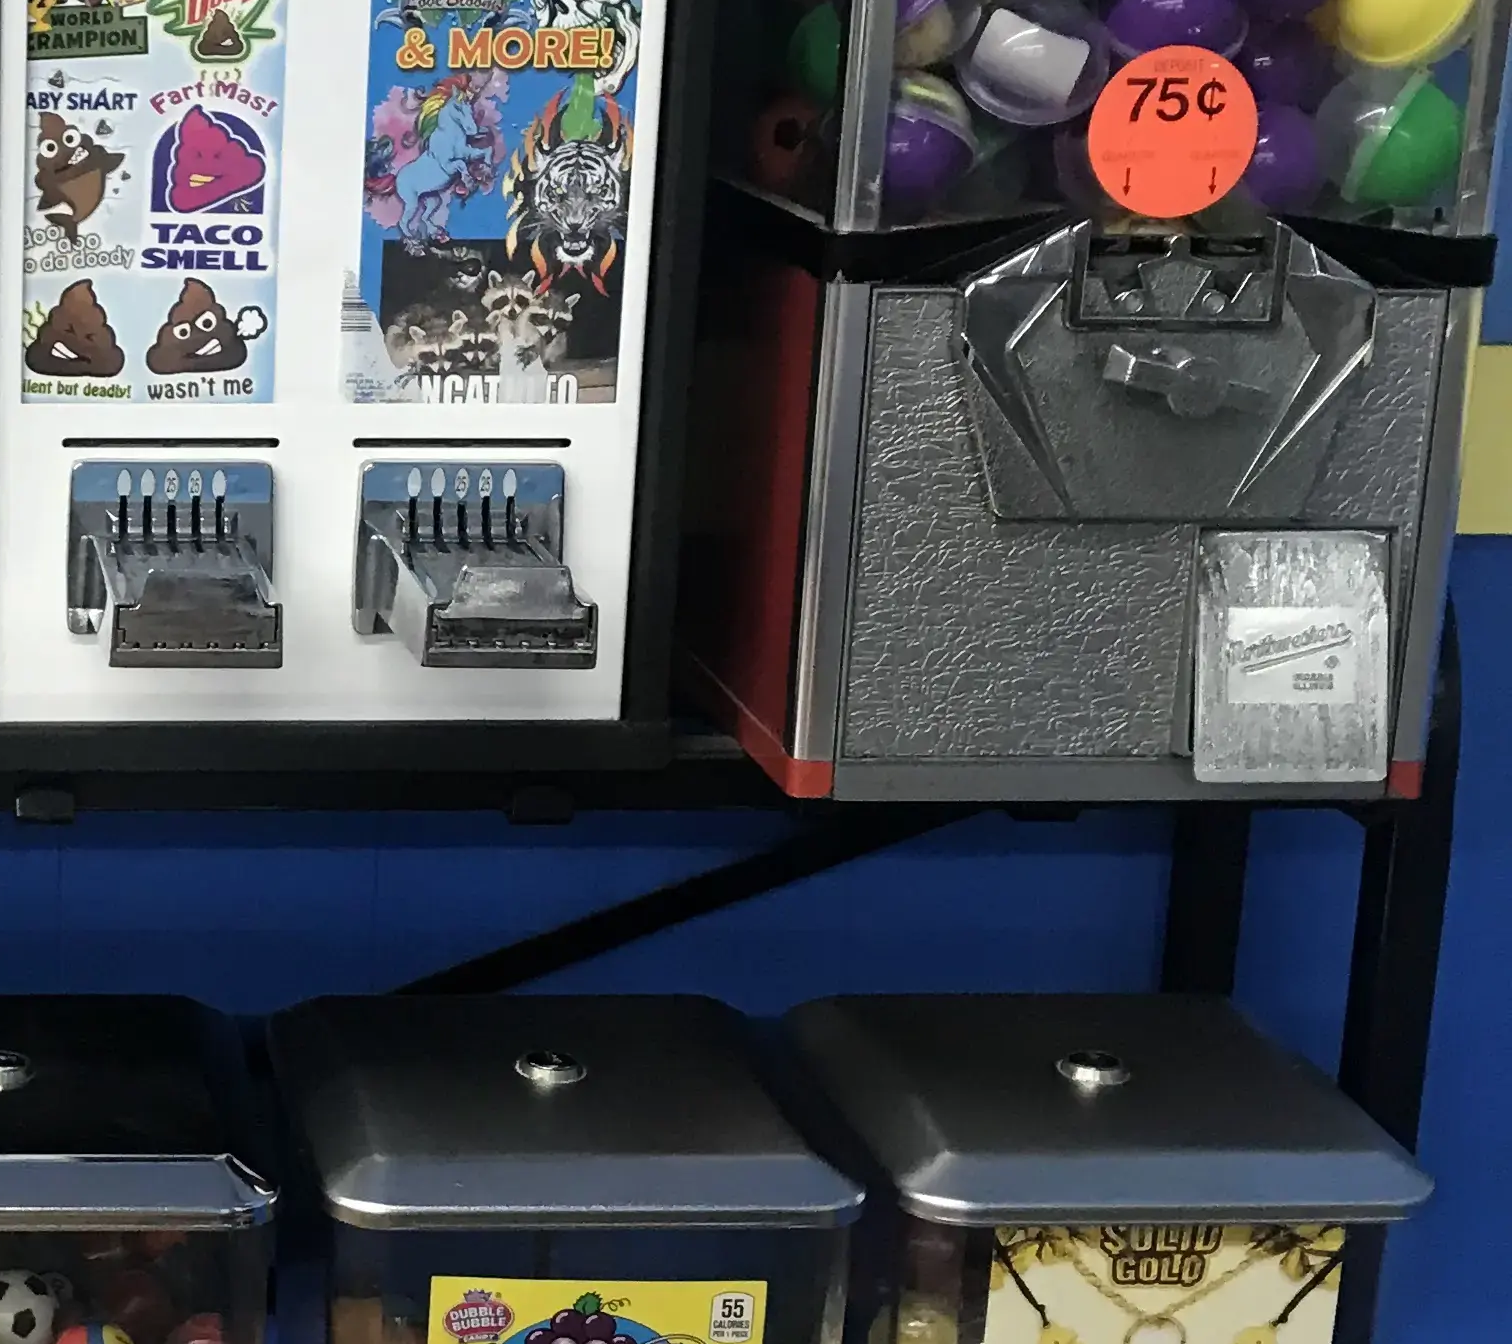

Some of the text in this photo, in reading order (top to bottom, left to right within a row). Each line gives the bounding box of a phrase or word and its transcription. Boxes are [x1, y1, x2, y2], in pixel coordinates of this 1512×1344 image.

[51, 10, 114, 27] WORLD
[395, 26, 616, 70] & MORE!
[27, 87, 138, 112] ABY SHART
[149, 80, 278, 118] Fart Mas!
[1126, 77, 1228, 123] 75¢
[150, 223, 263, 246] TACO
[41, 244, 135, 272] da doody
[141, 248, 268, 271] SMELL
[56, 379, 132, 398] but deadly!
[146, 376, 254, 400] wasn't me
[1116, 1253, 1203, 1284] GOLD
[449, 1306, 505, 1321] DUBBLE
[721, 1298, 745, 1319] 55
[451, 1316, 507, 1332] BUBBLE
[713, 1320, 750, 1329] CALORIES
